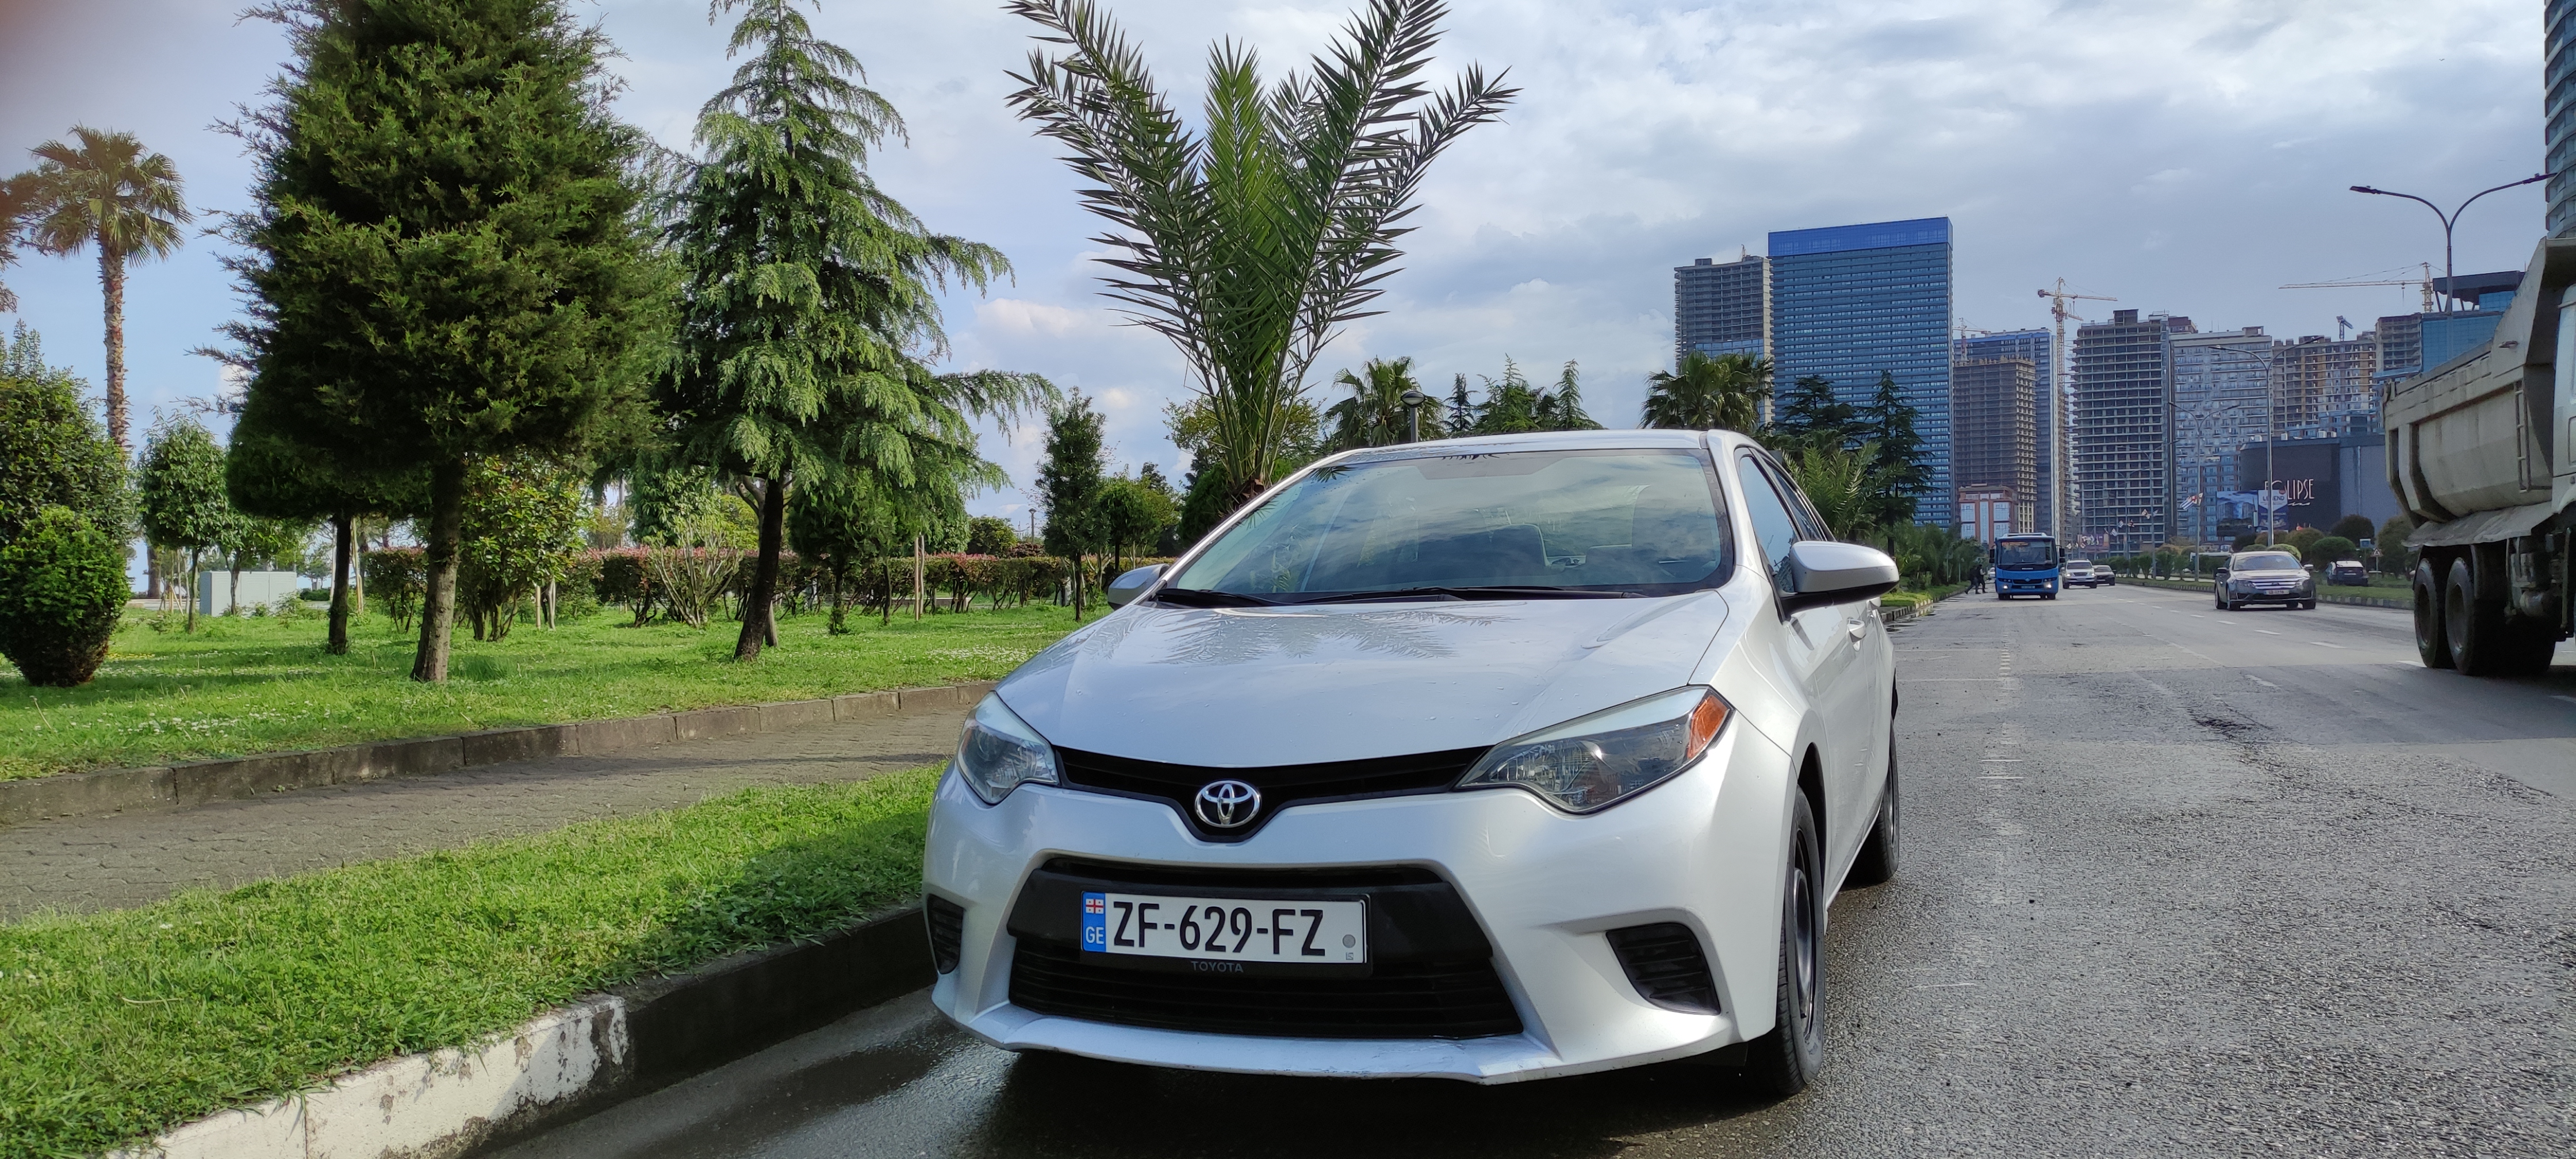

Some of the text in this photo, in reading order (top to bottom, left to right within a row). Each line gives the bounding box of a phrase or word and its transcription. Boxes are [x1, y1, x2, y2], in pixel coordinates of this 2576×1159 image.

[1086, 901, 1325, 957] GE ZF-629-FZ
[1190, 961, 1244, 973] TOYOTA
